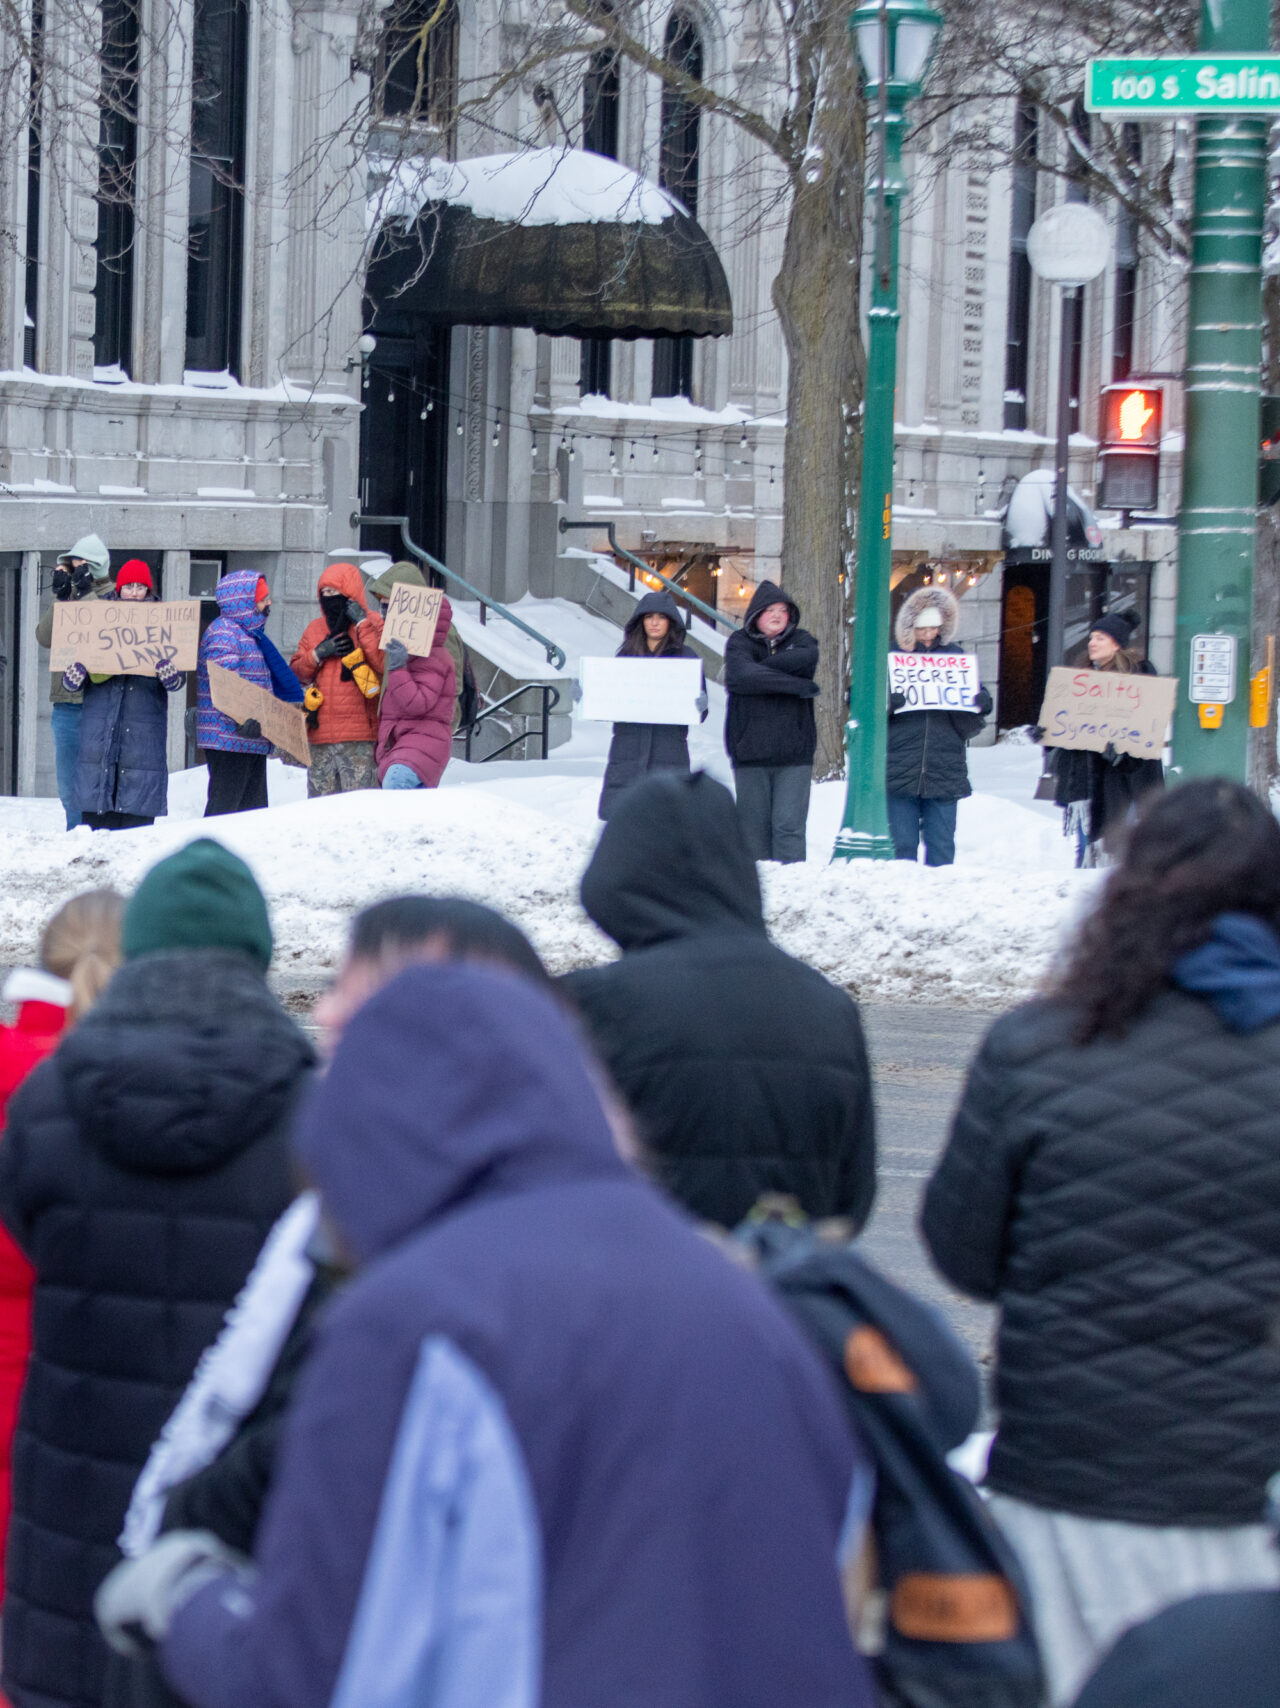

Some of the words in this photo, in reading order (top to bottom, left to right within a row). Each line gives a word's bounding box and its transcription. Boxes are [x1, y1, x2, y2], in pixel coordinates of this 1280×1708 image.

[1111, 75, 1156, 100] 100
[1161, 75, 1180, 100] S
[1195, 65, 1280, 100] Salin
[60, 606, 93, 626] NO
[104, 606, 139, 625] ONE
[146, 607, 161, 624] IS
[165, 606, 196, 623] ILLEGAL
[387, 586, 442, 623] ABOLISH
[66, 631, 90, 646] ON
[98, 624, 173, 651] STOLEN
[390, 618, 420, 641] ICE
[116, 644, 179, 671] LAND
[893, 655, 918, 667] NO
[920, 656, 971, 669] MORE
[893, 668, 969, 685] SECRET
[1072, 673, 1142, 710] Salty
[1051, 709, 1157, 748] Syracuse!
